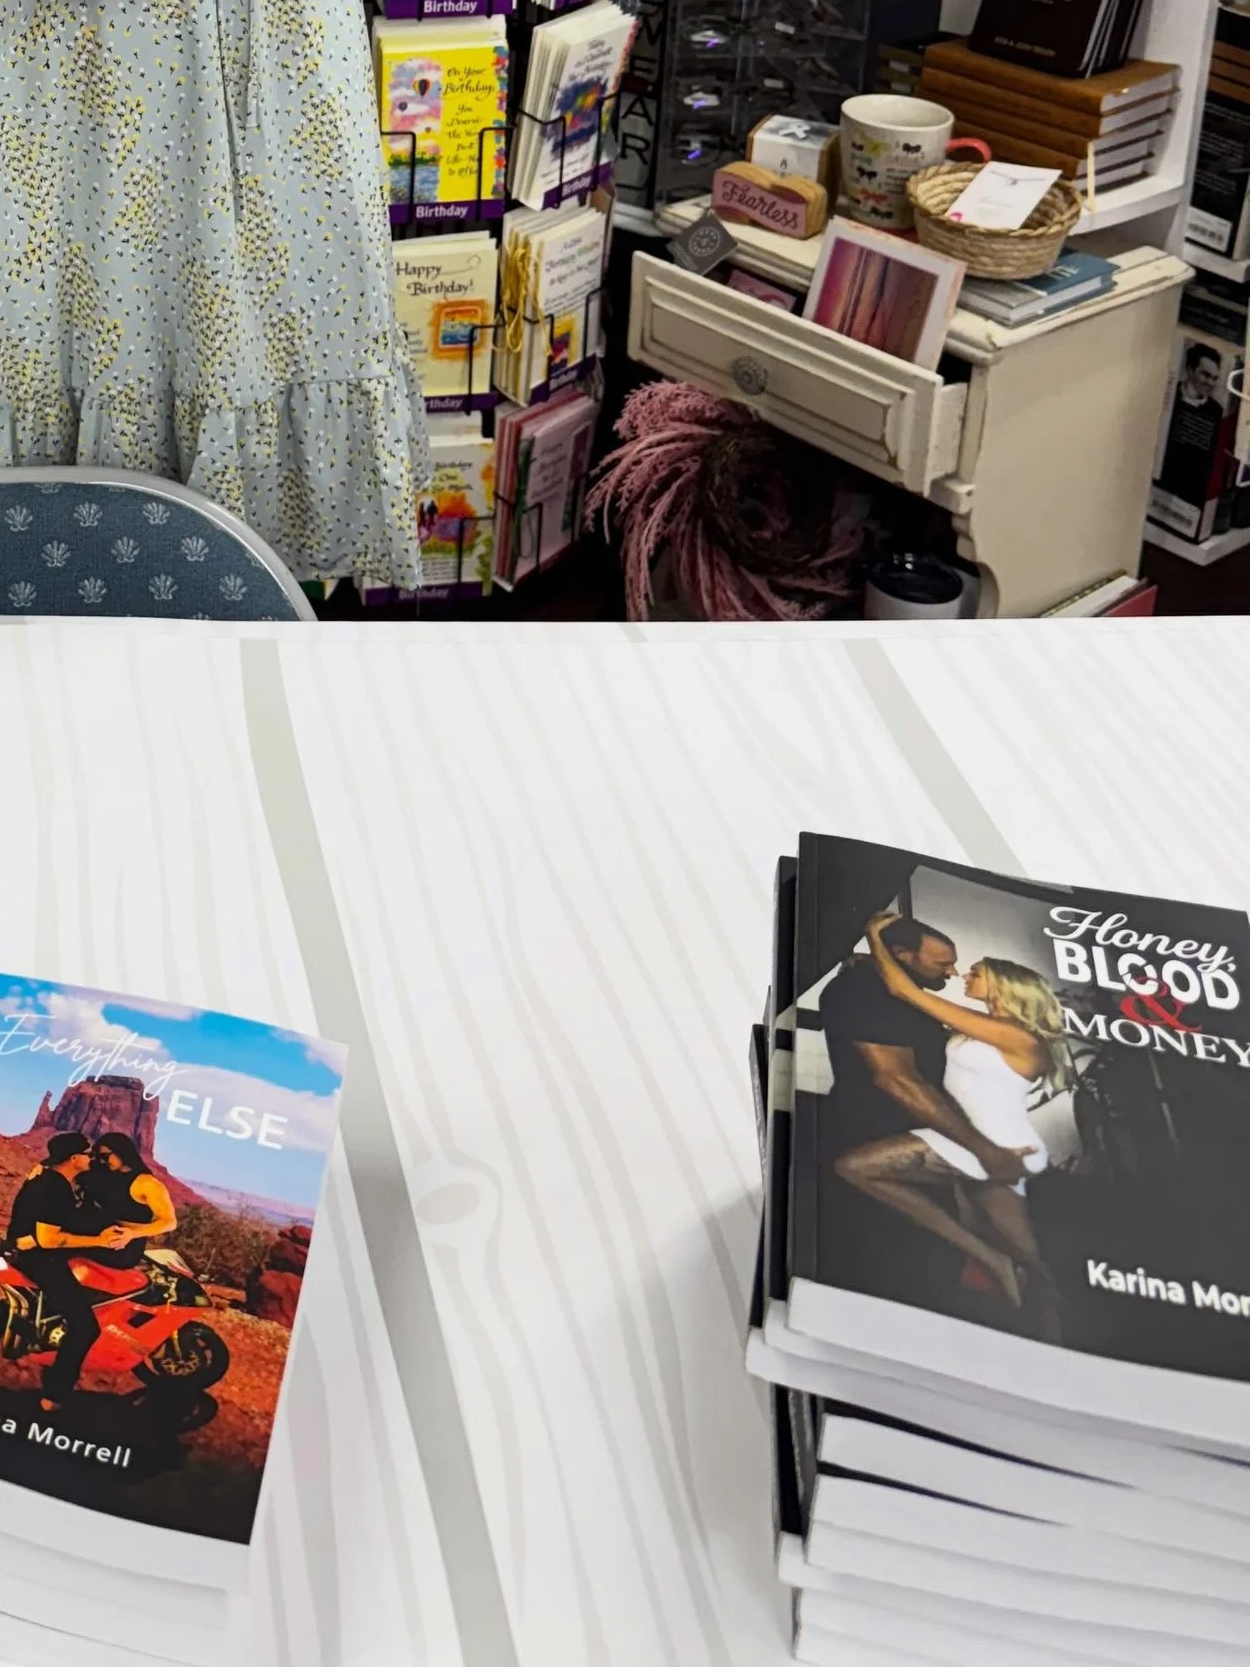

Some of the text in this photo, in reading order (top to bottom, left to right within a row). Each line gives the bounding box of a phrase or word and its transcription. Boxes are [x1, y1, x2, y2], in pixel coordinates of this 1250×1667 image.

[447, 67, 485, 80] On Your
[416, 204, 468, 218] Birthday
[722, 181, 800, 232] Fearless
[396, 263, 442, 279] Happy
[425, 396, 464, 411] rthday
[1042, 905, 1237, 973] Honey,
[1052, 940, 1242, 1012] BLOOD
[1120, 976, 1202, 1034] &
[1061, 1008, 1250, 1070] MONEY
[165, 1088, 289, 1151] ELSE
[1087, 1259, 1185, 1306] Karina
[27, 1422, 132, 1469] Morrell
